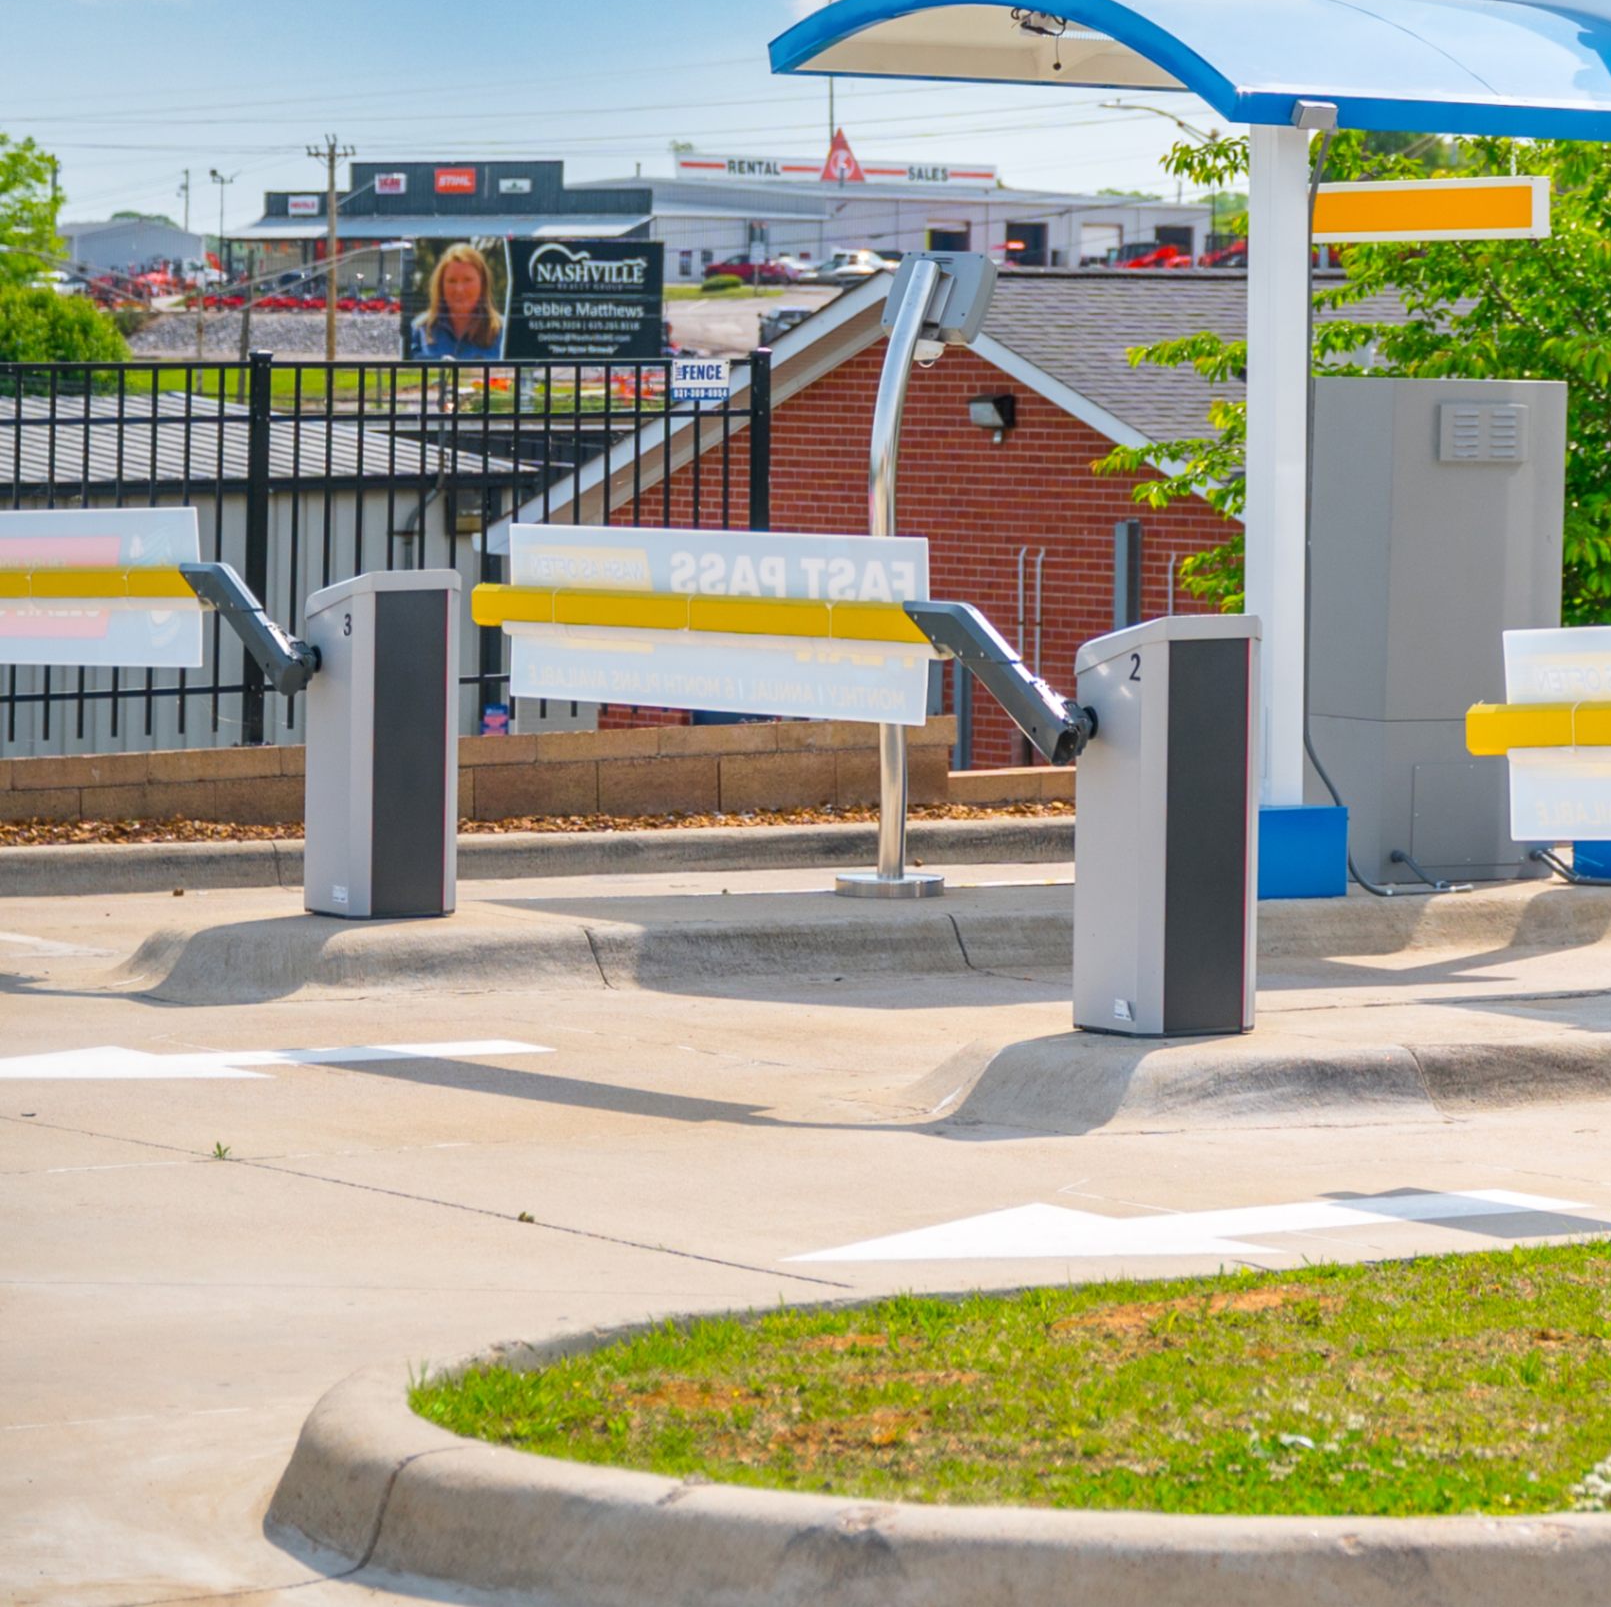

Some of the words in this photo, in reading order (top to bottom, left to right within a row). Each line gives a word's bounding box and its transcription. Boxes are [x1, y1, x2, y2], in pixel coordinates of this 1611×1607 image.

[728, 159, 781, 175] RENTAL
[908, 166, 948, 181] SALES
[439, 176, 472, 186] STIHL
[536, 263, 645, 283] NASHVILLE
[523, 302, 573, 316] Debbie
[576, 303, 645, 318] Matthews
[343, 613, 352, 636] 3
[1129, 653, 1141, 682] 2
